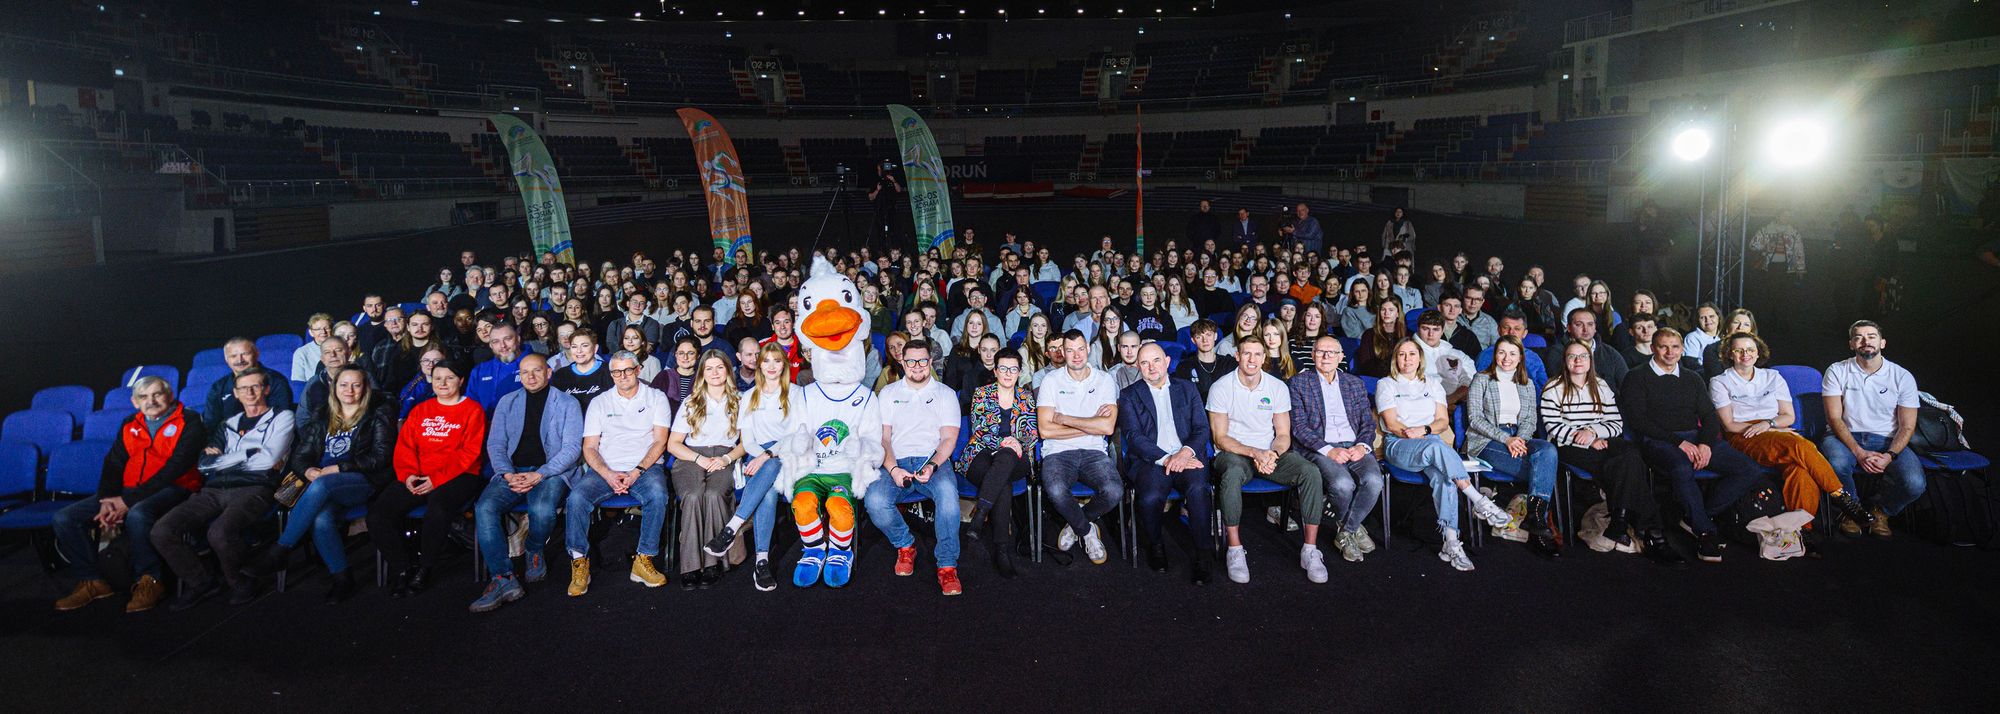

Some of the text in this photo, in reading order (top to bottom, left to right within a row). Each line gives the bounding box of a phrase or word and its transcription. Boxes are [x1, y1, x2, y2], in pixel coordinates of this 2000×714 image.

[766, 61, 776, 69] P2
[943, 160, 987, 178] ORUŃ
[422, 426, 451, 437] Brand
